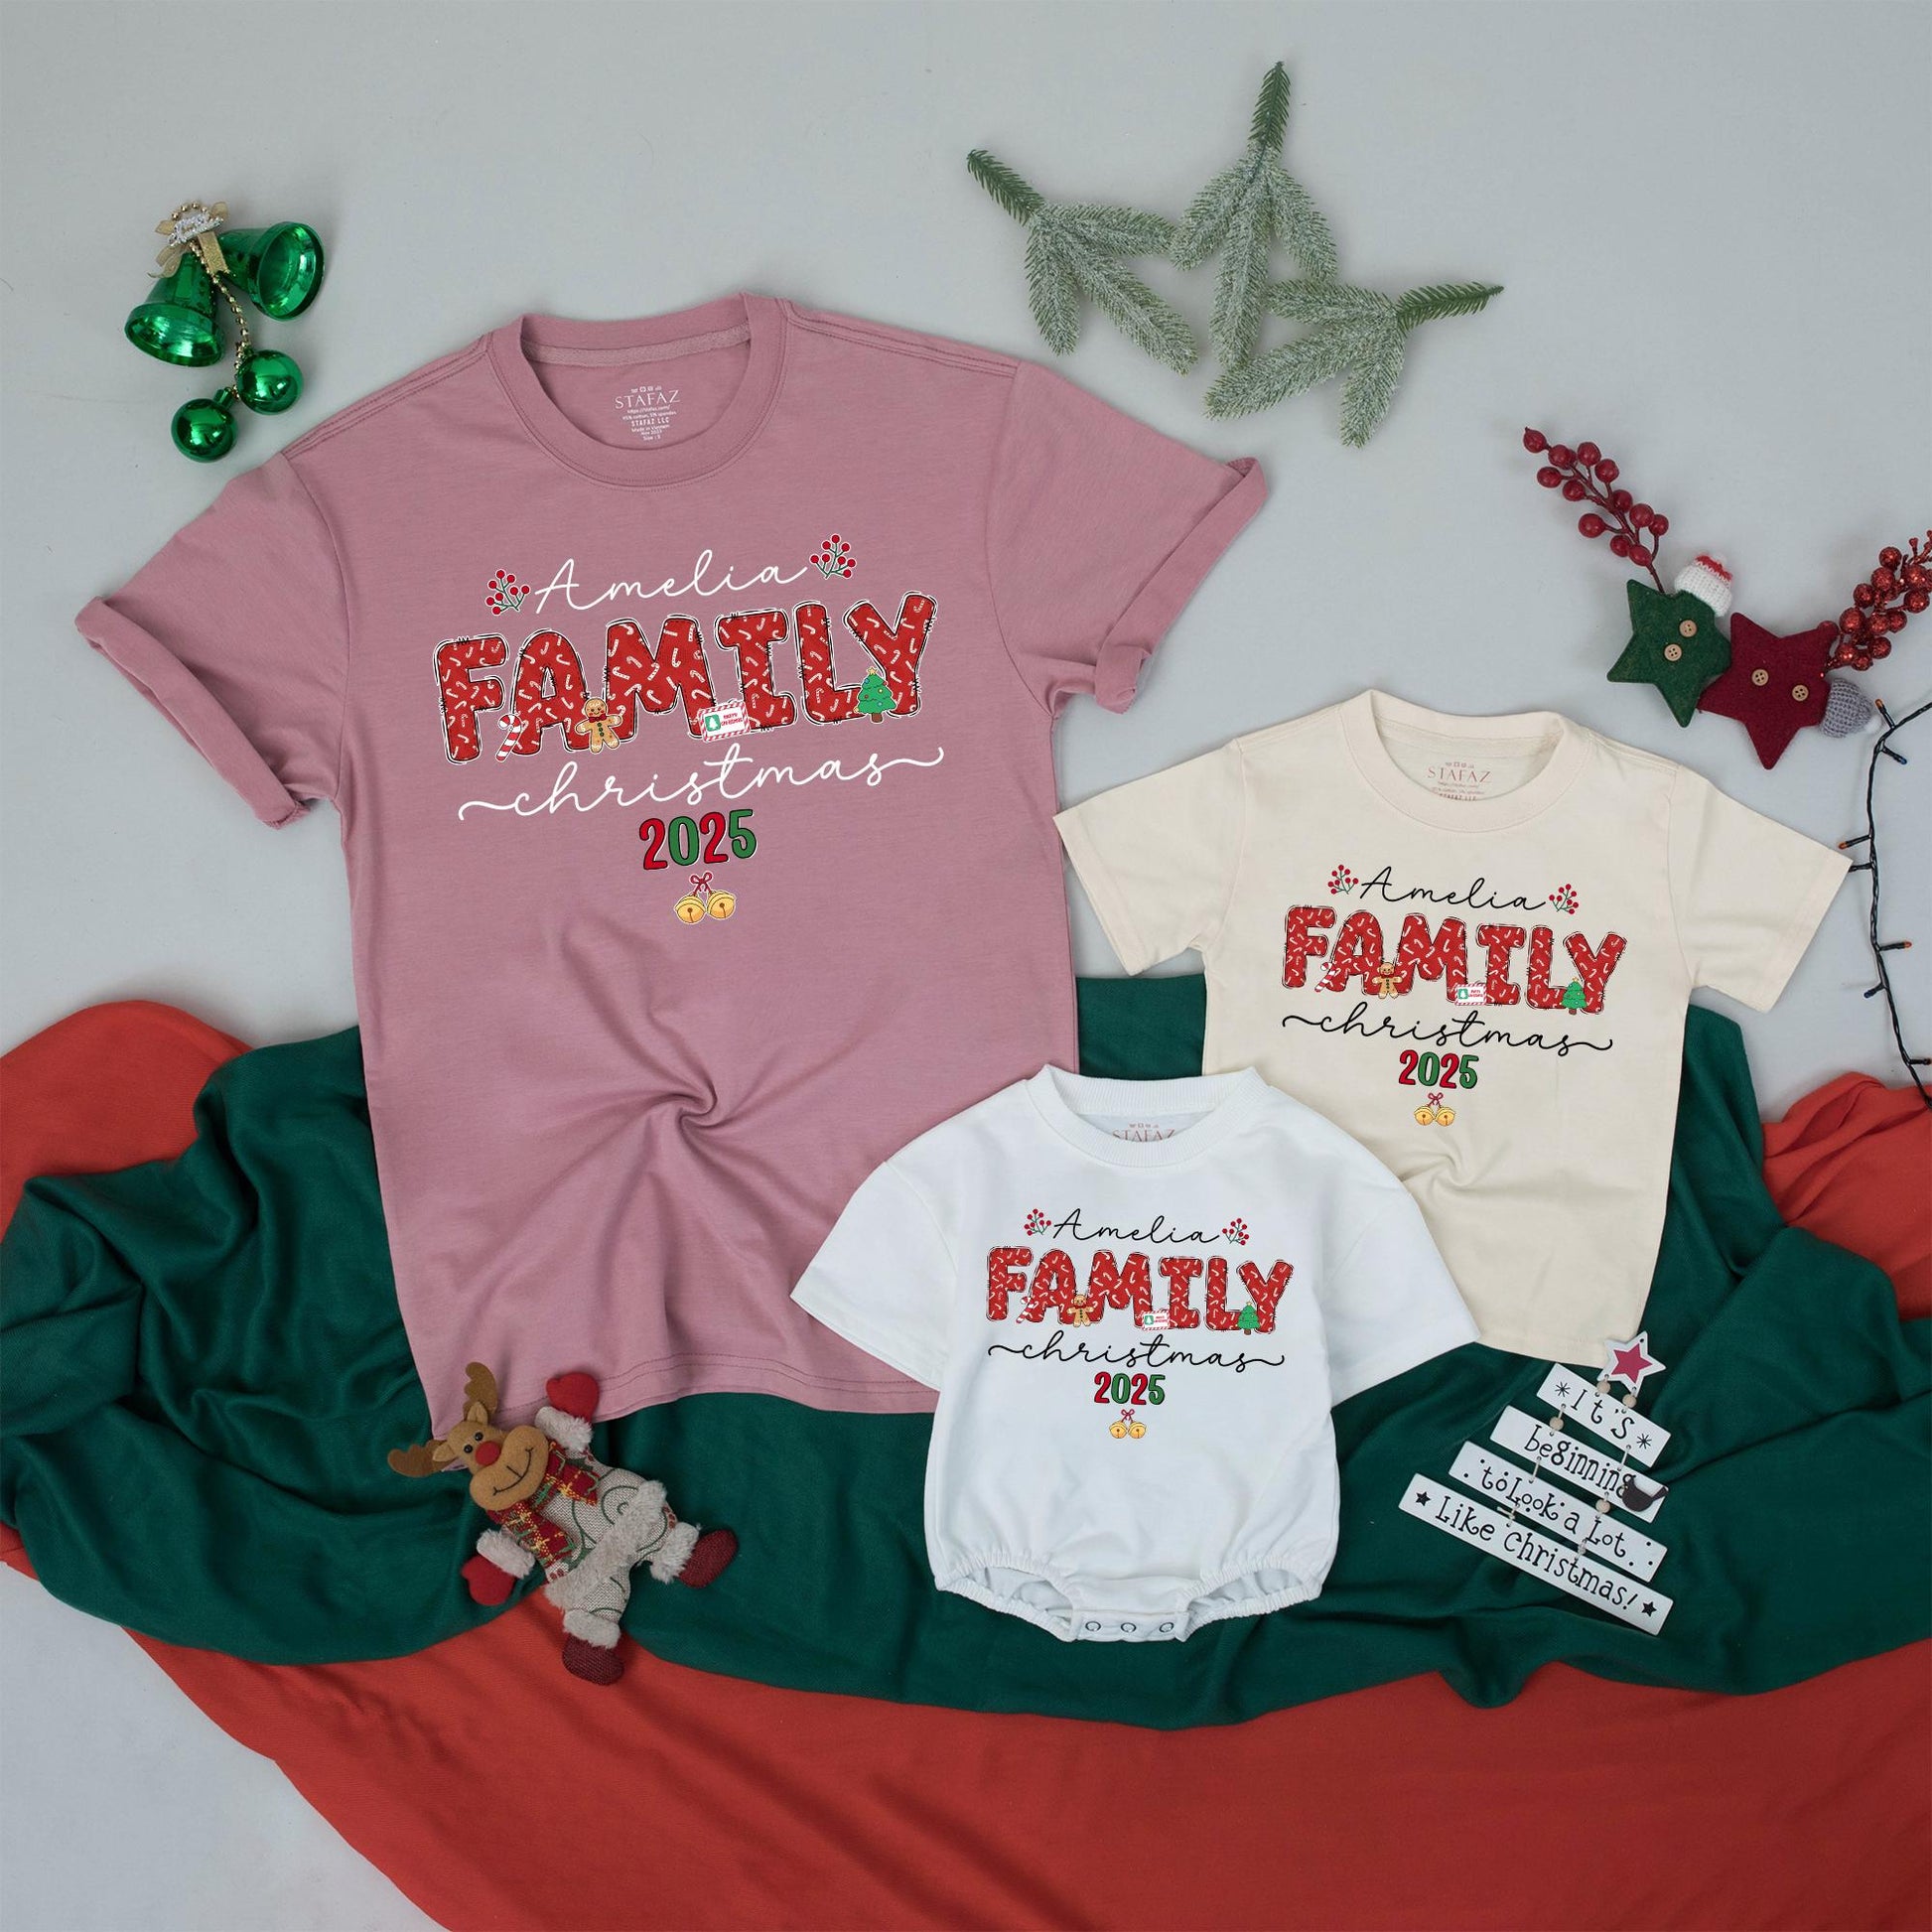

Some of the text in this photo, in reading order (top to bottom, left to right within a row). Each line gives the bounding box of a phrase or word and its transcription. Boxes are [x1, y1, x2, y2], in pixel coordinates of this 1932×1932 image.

[615, 389, 680, 409] STAFAZ
[630, 417, 655, 427] STAFAZ
[535, 550, 808, 614] Amelia
[434, 591, 938, 764] FAMILY
[459, 743, 945, 820] christmas
[638, 809, 758, 871] 2025
[1359, 866, 1547, 911] Amelia
[1282, 904, 1628, 1016] FAMILY
[1282, 1001, 1614, 1057] christmas
[1398, 1049, 1479, 1090] 2025
[1052, 1207, 1221, 1244] Amelia
[986, 1246, 1295, 1334] FAMILY
[987, 1329, 1286, 1373] christmas
[1093, 1371, 1167, 1406] 2025
